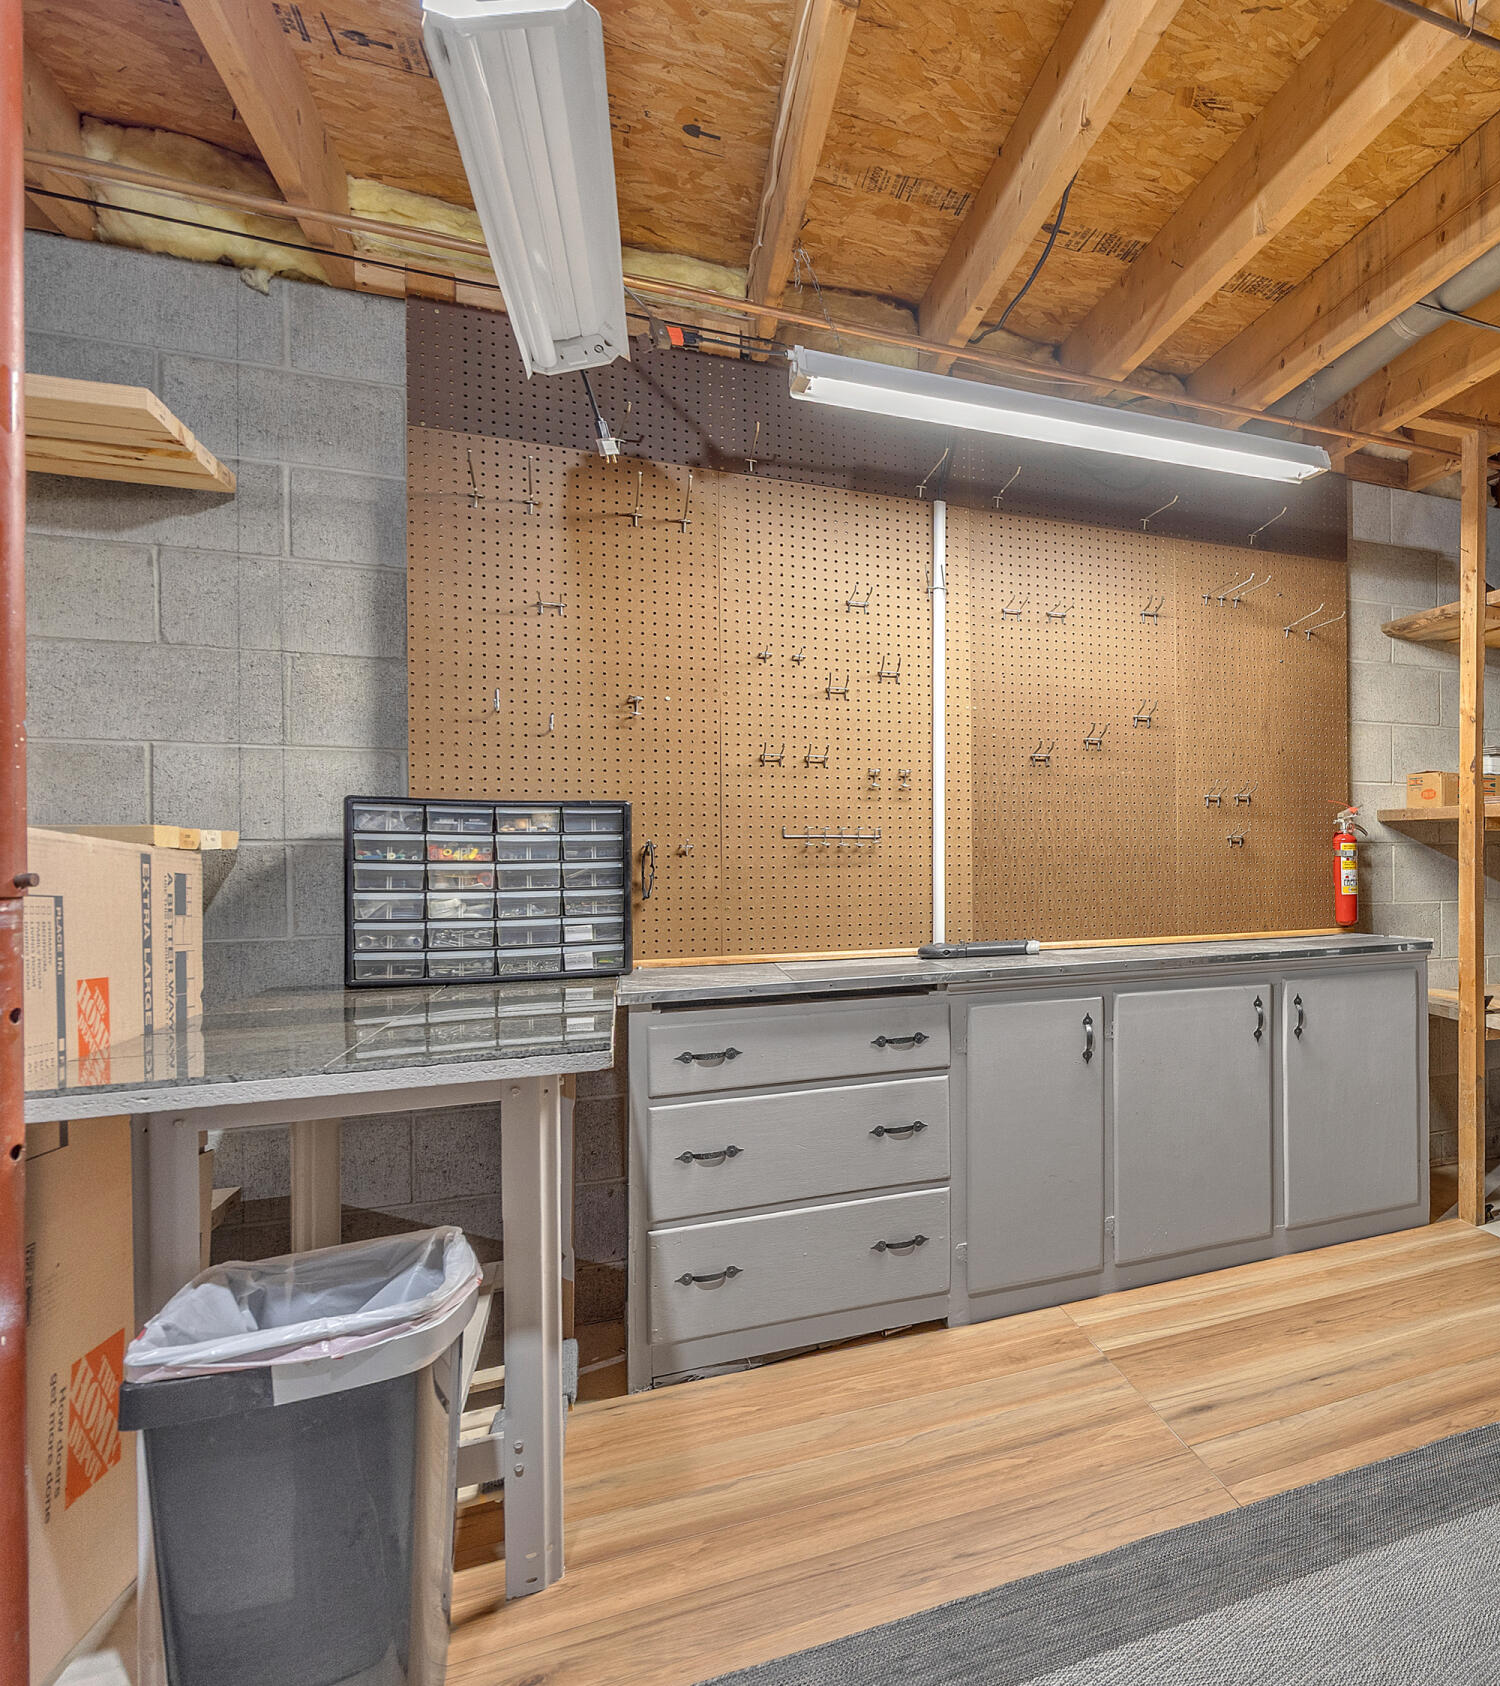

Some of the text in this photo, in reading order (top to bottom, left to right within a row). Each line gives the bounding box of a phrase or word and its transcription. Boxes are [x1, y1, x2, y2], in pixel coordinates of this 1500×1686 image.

[142, 863, 152, 1026] EXTRA LARGE
[77, 980, 111, 1050] HOME
[43, 1372, 58, 1526] get more done
[53, 1386, 67, 1500] How doers
[69, 1357, 121, 1468] HOME
